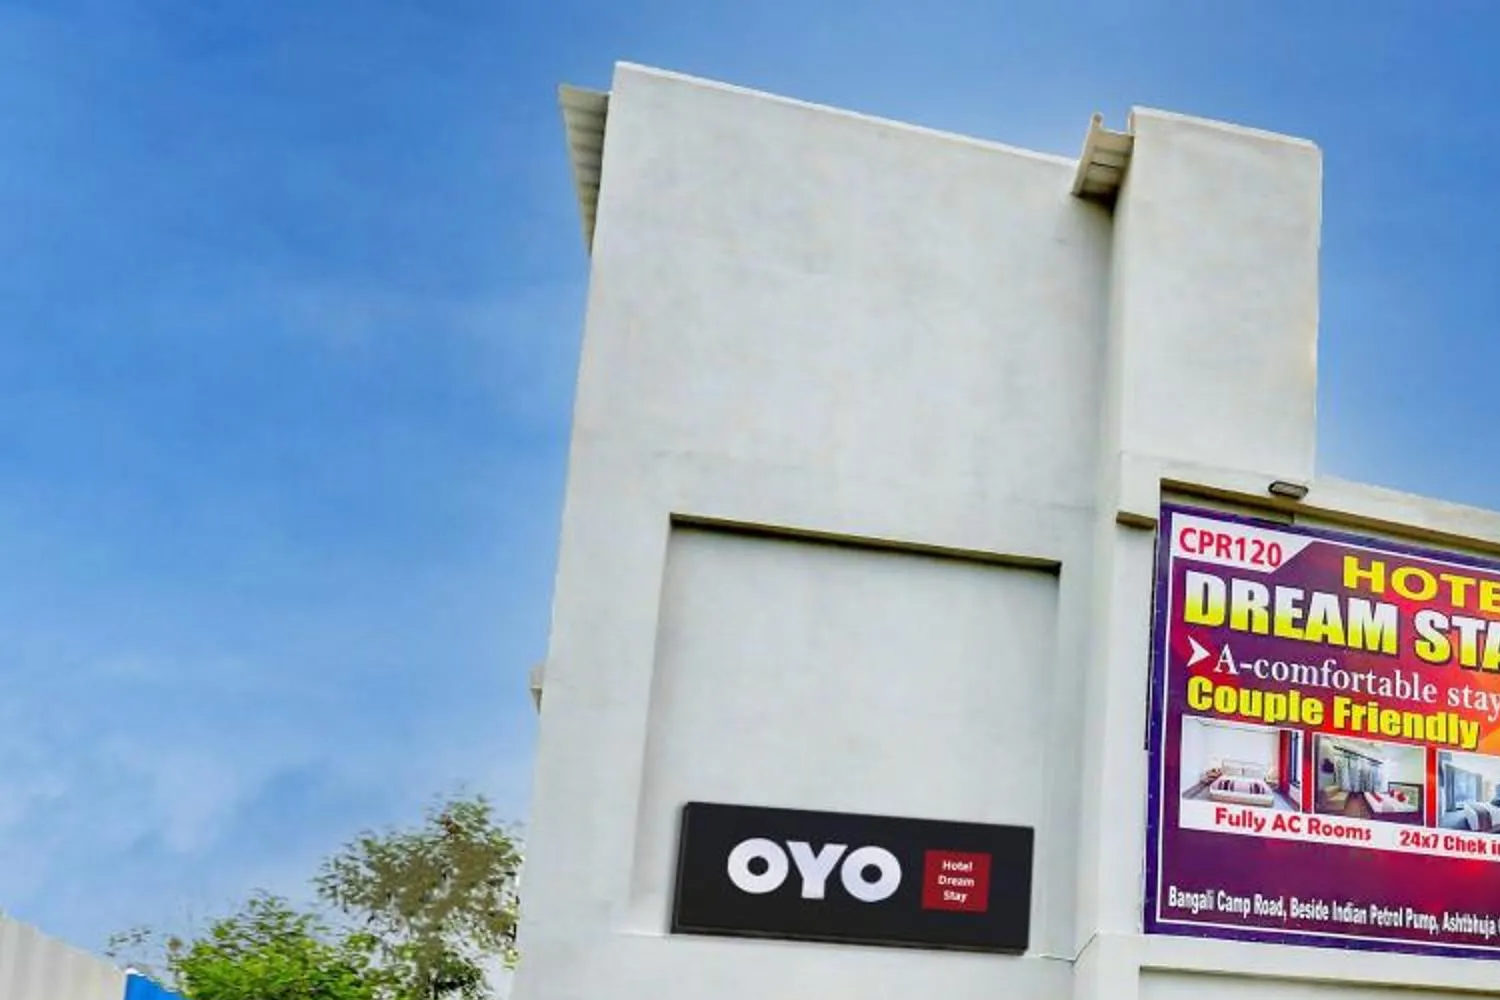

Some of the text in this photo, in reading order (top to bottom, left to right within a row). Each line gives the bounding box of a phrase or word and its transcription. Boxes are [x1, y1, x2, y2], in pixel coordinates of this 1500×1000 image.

[1179, 526, 1283, 567] CPR120
[1184, 571, 1399, 656] DREAM
[1213, 644, 1438, 703] A-comfortable
[1187, 675, 1479, 750] Couple Friendly
[1215, 807, 1372, 842] Fully AC Rooms
[1400, 829, 1439, 850] 24x7
[1443, 836, 1487, 855] Chek
[727, 837, 902, 903] OYO
[938, 874, 976, 889] Dream
[942, 860, 974, 873] Hotel
[943, 889, 969, 904] Stay
[1168, 885, 1215, 914] Bangali
[1217, 889, 1251, 919] Camp
[1253, 893, 1288, 922] Road,
[1290, 897, 1330, 921] Beside
[1332, 901, 1367, 925] Indian
[1369, 904, 1403, 928] Petrol
[1405, 908, 1440, 935] Pump,
